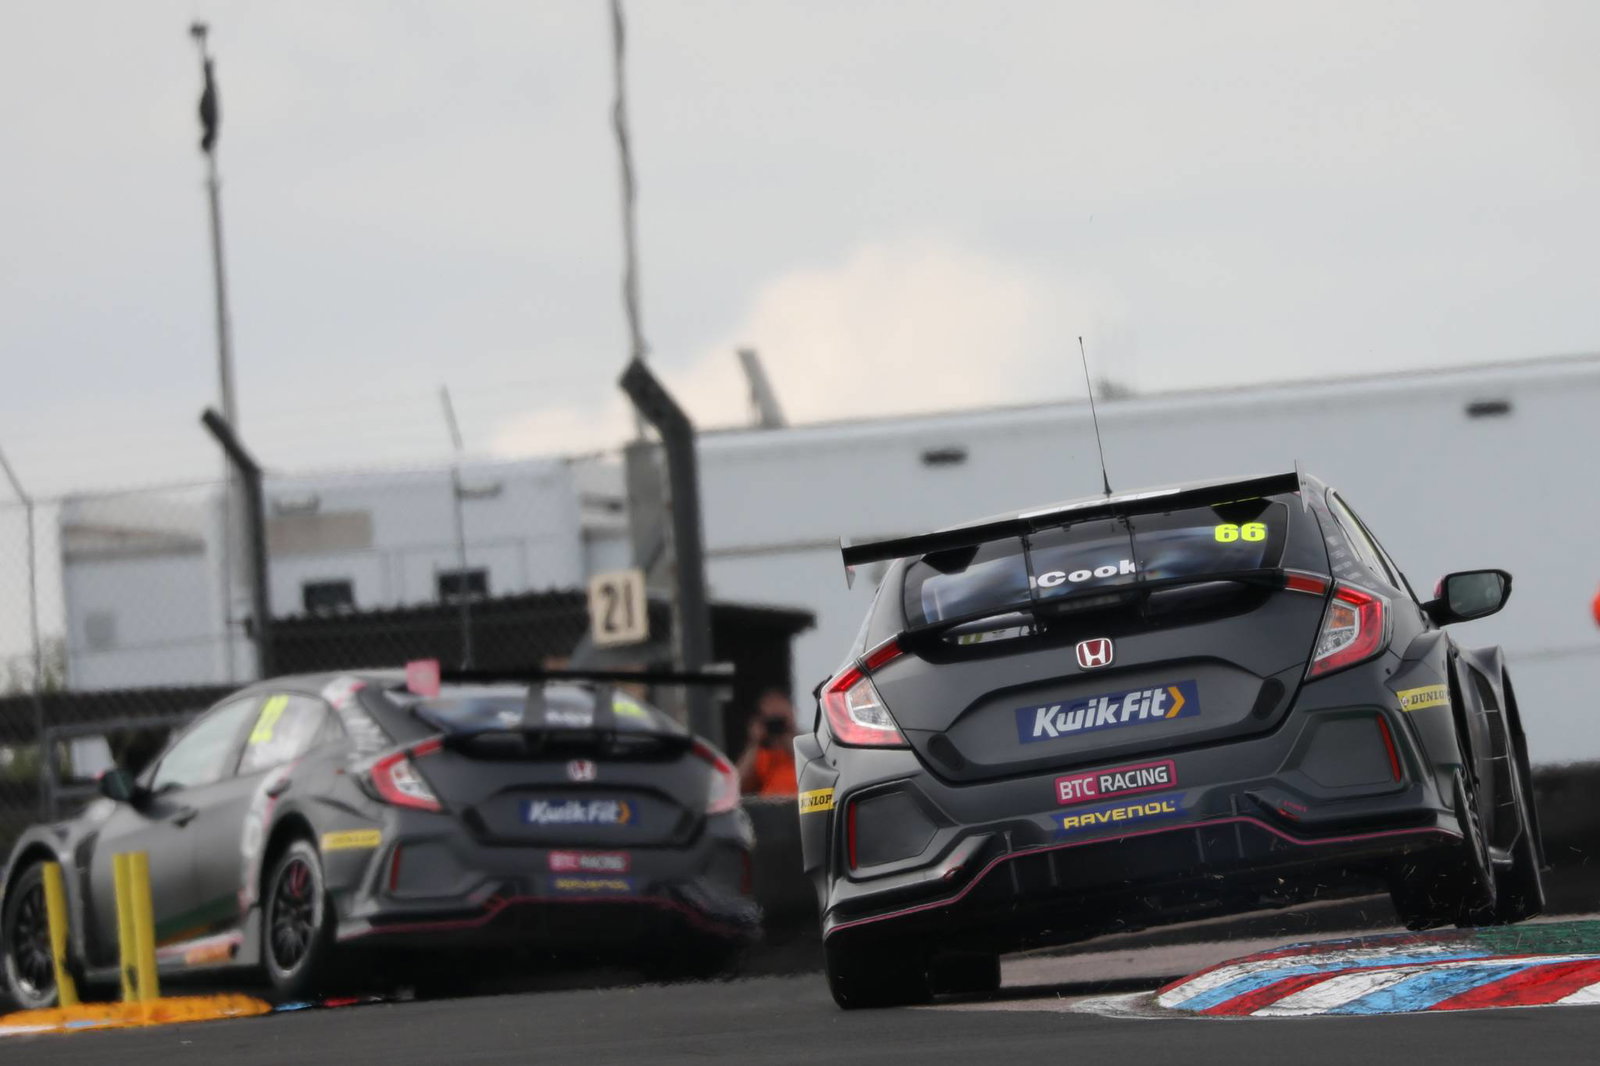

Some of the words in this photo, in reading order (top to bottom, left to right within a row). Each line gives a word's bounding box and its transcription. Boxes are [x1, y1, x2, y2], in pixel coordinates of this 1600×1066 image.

[1214, 523, 1266, 543] 66
[1037, 559, 1137, 589] Cook
[600, 581, 634, 633] 21
[1059, 777, 1096, 800] BTC
[1099, 766, 1169, 793] RACING
[1063, 801, 1176, 830] RAVENOL
